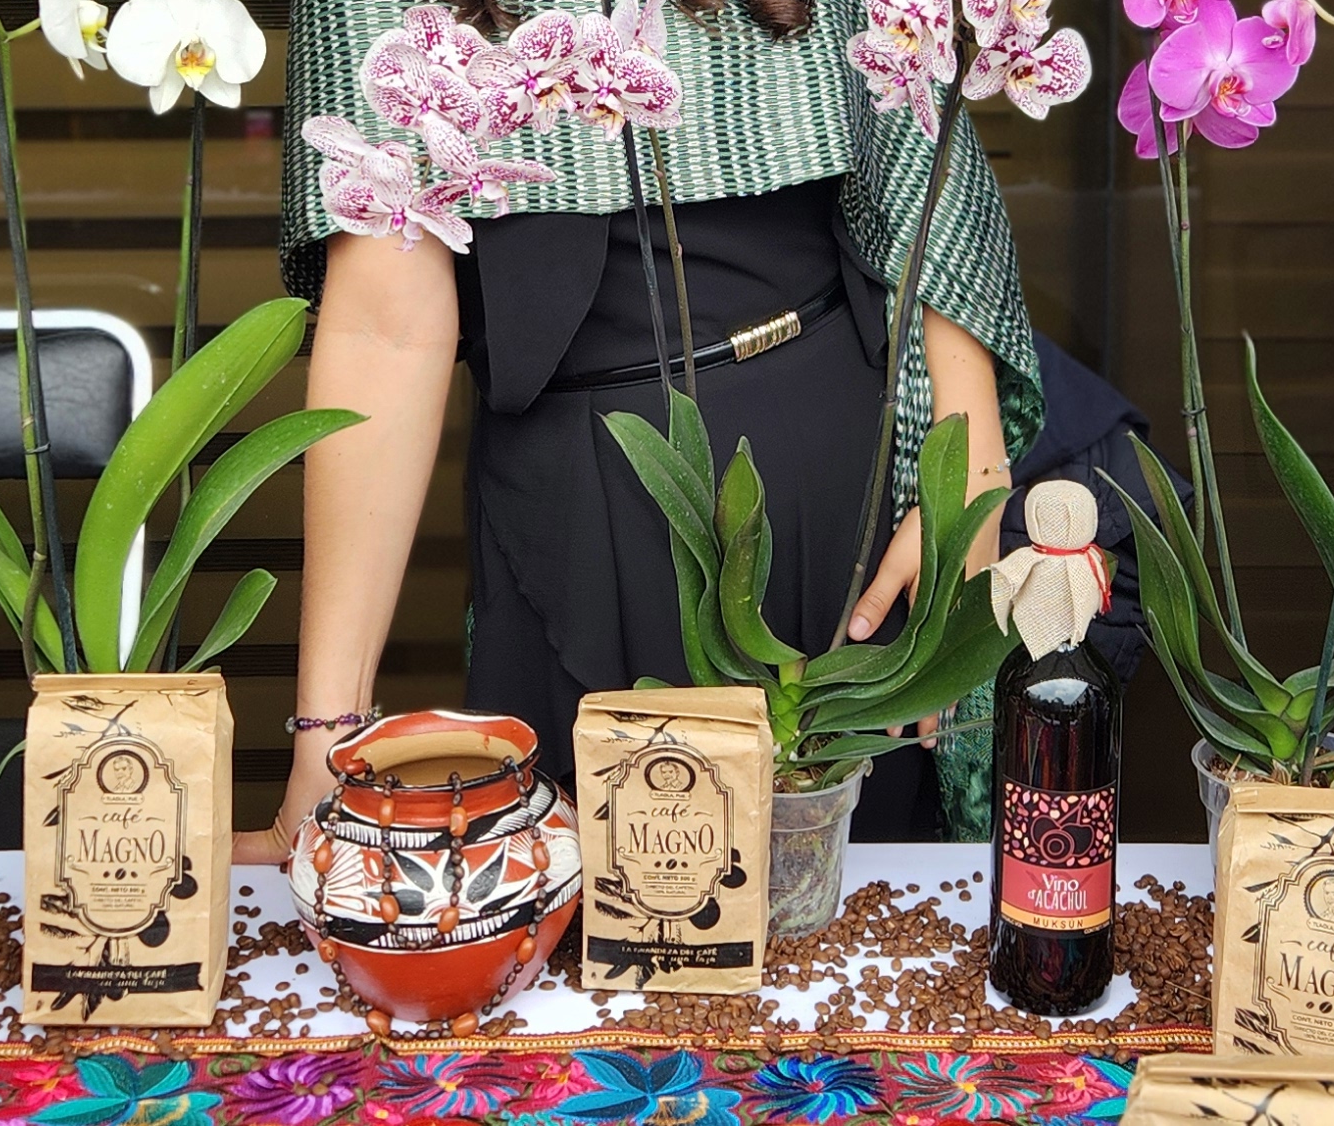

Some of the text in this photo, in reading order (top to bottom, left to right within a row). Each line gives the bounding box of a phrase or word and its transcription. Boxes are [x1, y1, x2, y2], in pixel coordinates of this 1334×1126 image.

[102, 807, 143, 830] café
[651, 803, 691, 823] café
[77, 828, 165, 864] MAGNO
[628, 822, 714, 855] MAGNO
[1042, 873, 1079, 892] Vino
